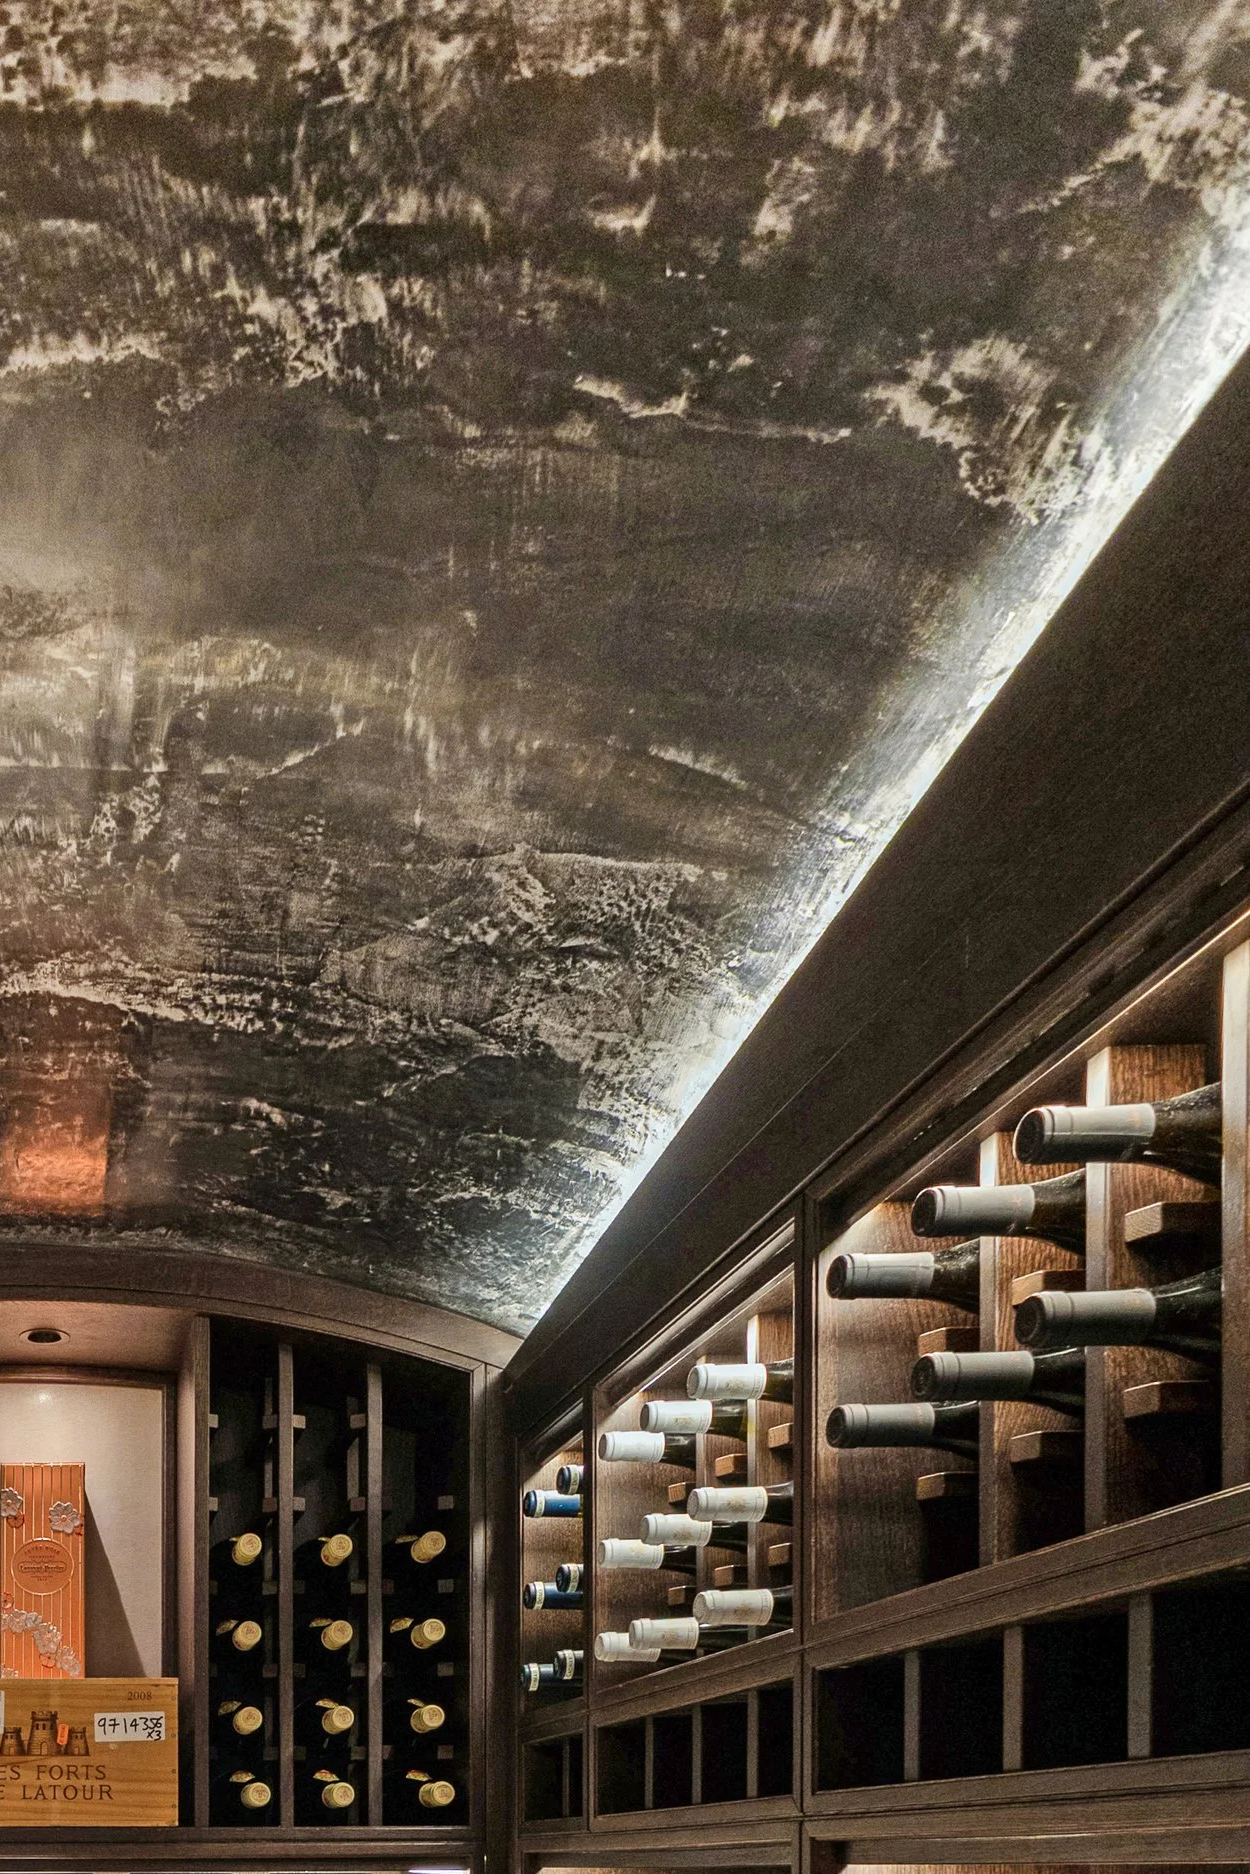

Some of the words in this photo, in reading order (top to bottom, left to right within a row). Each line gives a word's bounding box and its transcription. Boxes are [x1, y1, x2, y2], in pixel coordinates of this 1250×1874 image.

[128, 1691, 152, 1701] 2008
[97, 1716, 164, 1735] 9714356
[36, 1764, 107, 1781] FORTS
[22, 1784, 114, 1801] LATOUR
